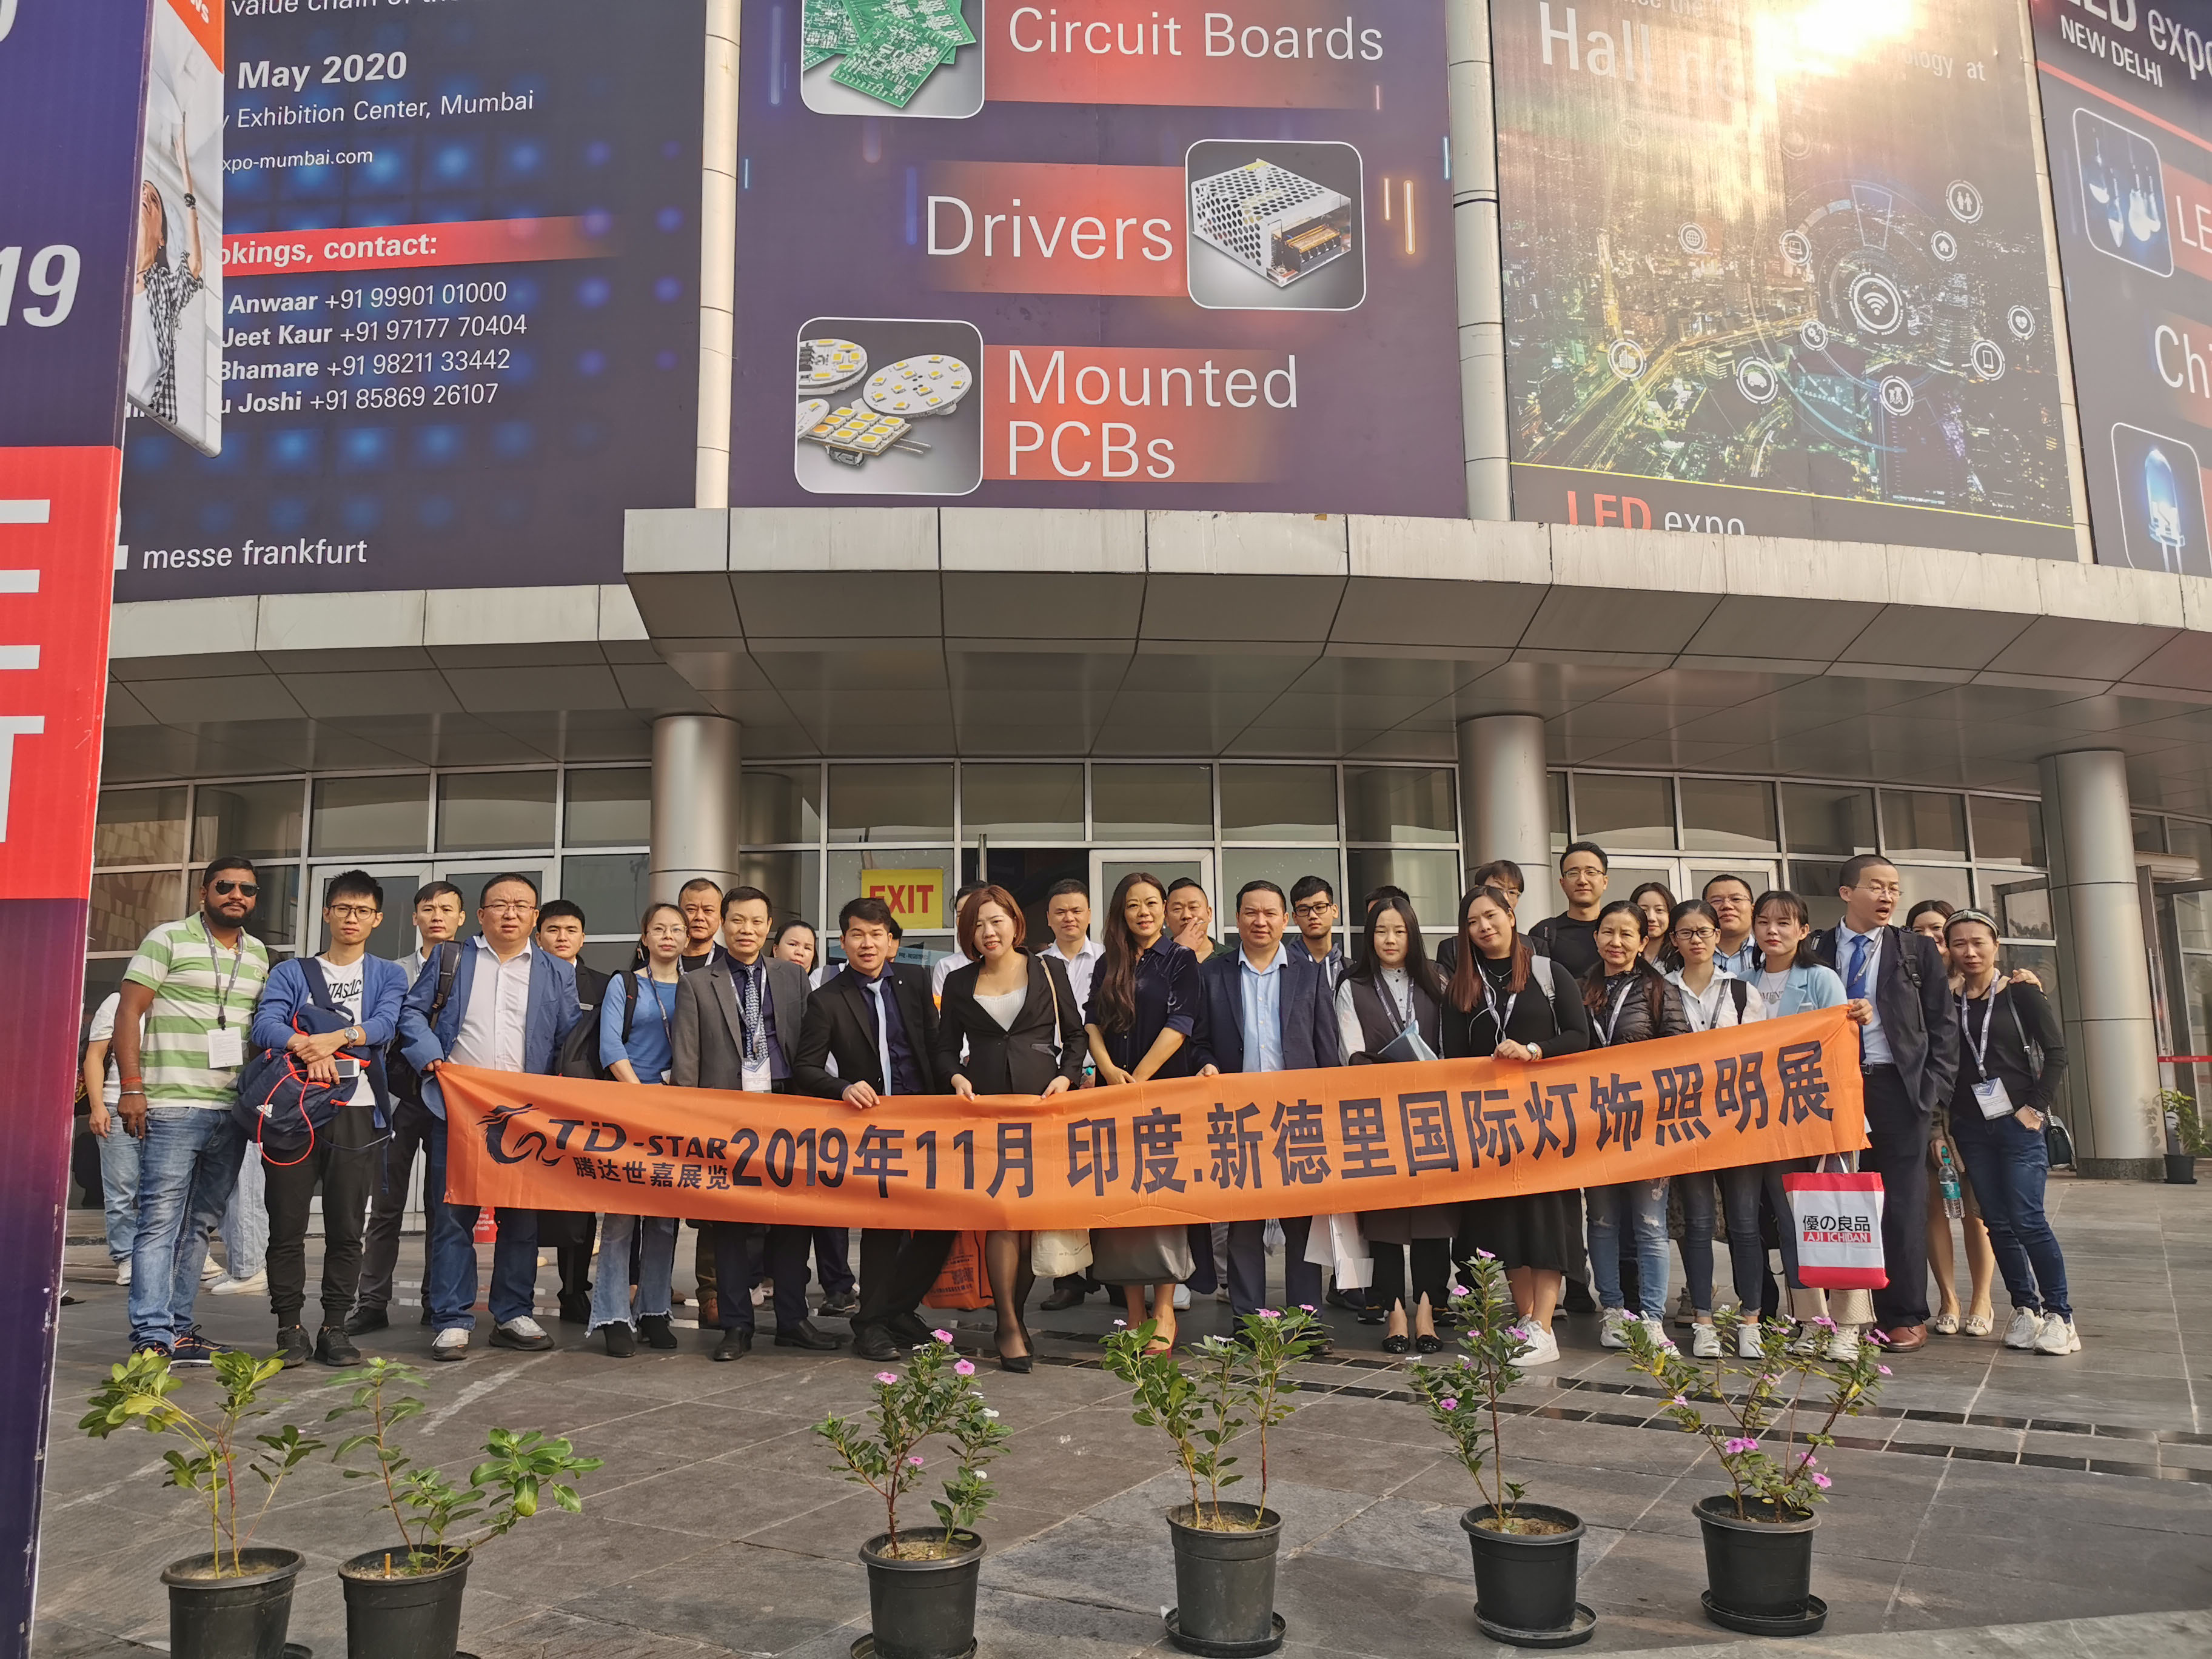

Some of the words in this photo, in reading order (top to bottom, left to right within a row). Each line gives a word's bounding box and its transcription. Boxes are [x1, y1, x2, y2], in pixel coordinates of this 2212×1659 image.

[233, 0, 298, 16] value
[1009, 7, 1181, 56] Circuit
[1204, 13, 1384, 61] Boards
[1540, 1, 1653, 85] Hall
[2060, 15, 2105, 58] NEW
[2111, 40, 2163, 87] DELHI
[238, 61, 311, 92] May
[321, 52, 407, 84] 2020
[1966, 60, 1986, 81] at
[237, 104, 344, 128] Exhibition
[354, 100, 431, 120] Center,
[441, 90, 534, 115] Mumbai
[927, 195, 1174, 261] Drivers
[324, 233, 437, 260] contact:
[228, 293, 318, 314] Anwaar
[325, 289, 362, 310] +91
[370, 286, 434, 309] 99901
[442, 281, 507, 304] 01000
[222, 326, 270, 347] Jeet
[278, 324, 333, 345] Kaur
[340, 322, 378, 343] +91
[386, 318, 450, 340] 97177
[458, 315, 527, 337] 70404
[221, 358, 319, 380] Bhamare
[327, 355, 366, 377] +91
[372, 352, 433, 374] 98211
[441, 349, 510, 371] 33442
[2154, 324, 2212, 398] Ch
[1007, 349, 1298, 409] Mounted
[238, 390, 302, 414] Joshi
[310, 389, 348, 411] +91
[356, 386, 425, 409] 85869
[433, 383, 498, 406] 26107
[1007, 421, 1176, 478] PCBs
[143, 545, 232, 569] messe
[243, 538, 367, 566] frankfurt
[573, 1156, 731, 1190] 腾达世嘉展览
[729, 1122, 1034, 1199] 2019年11月
[1803, 1215, 1871, 1232] 優の良品
[1807, 1232, 1824, 1242] AJI
[1827, 1232, 1868, 1243] ICHIBAN
